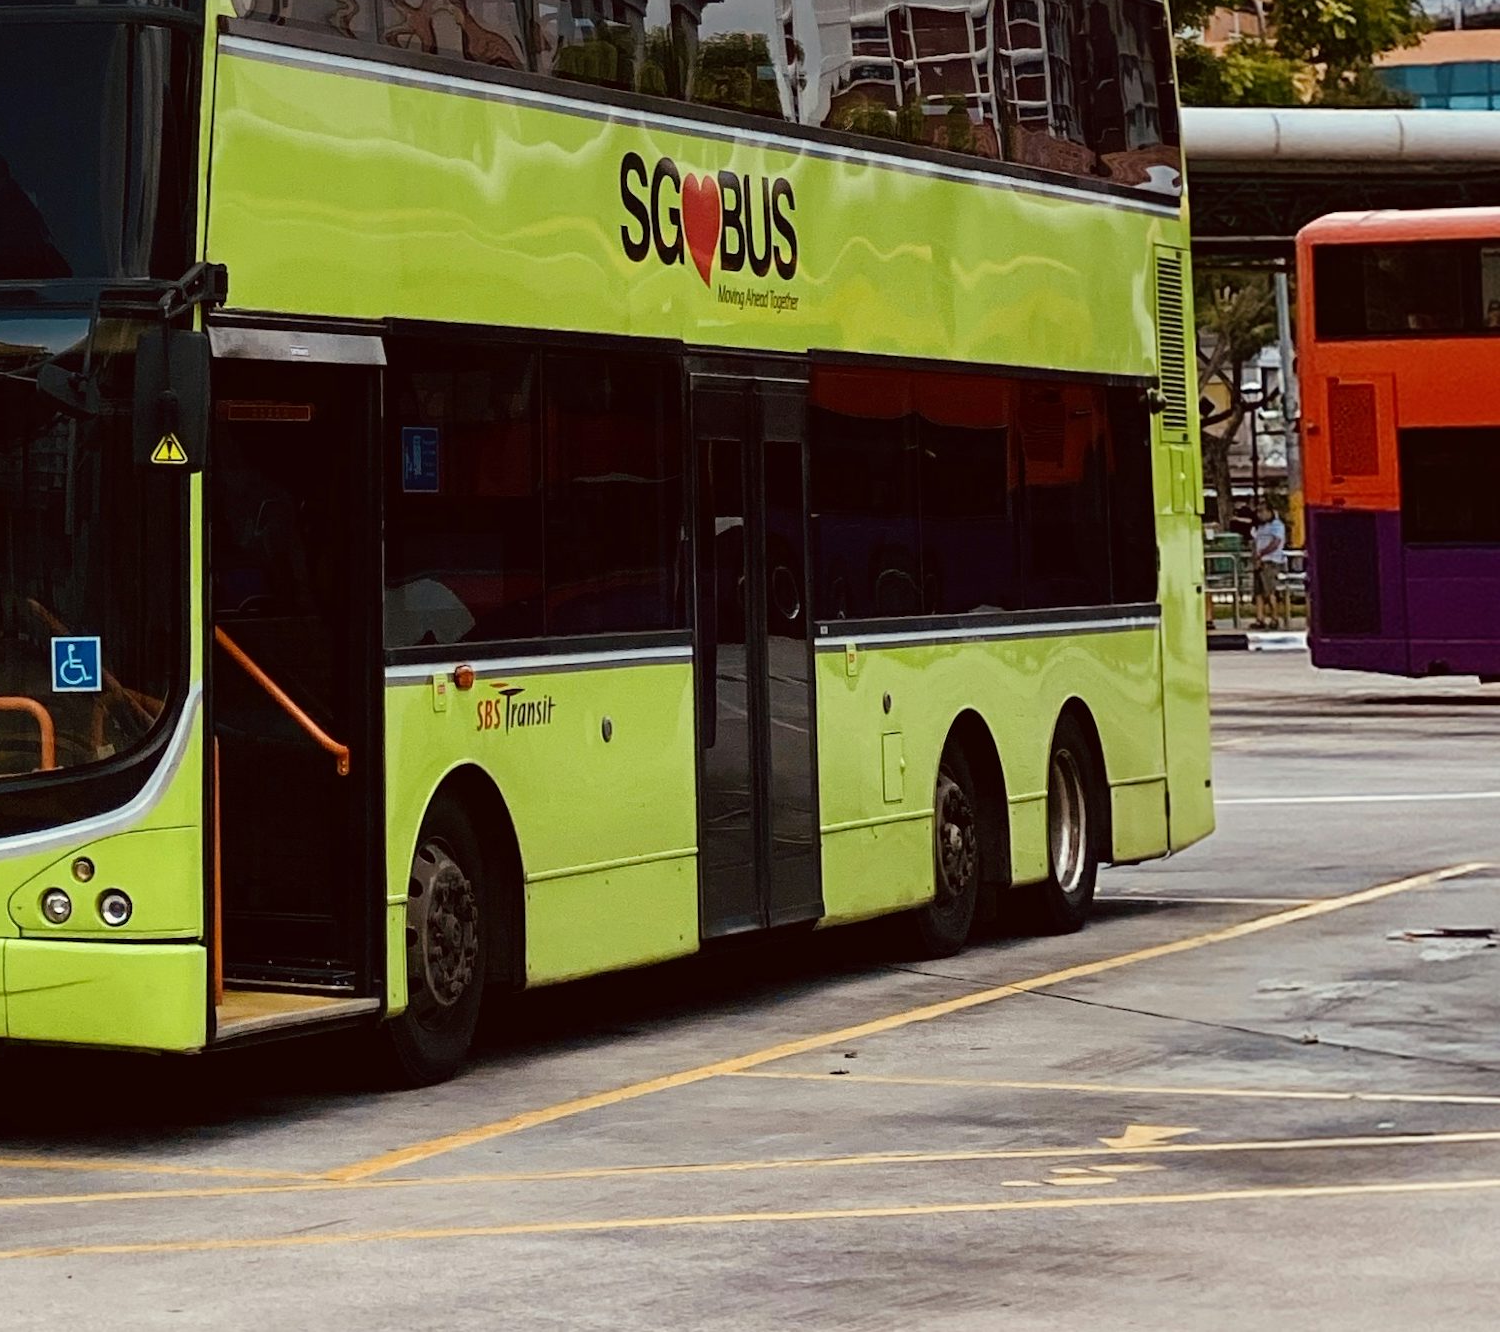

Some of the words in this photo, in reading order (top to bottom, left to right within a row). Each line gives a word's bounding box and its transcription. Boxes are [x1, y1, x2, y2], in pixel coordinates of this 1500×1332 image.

[717, 283, 745, 311] Moving
[745, 287, 769, 308] Ahead
[769, 289, 800, 314] Together
[476, 698, 501, 732] SBS
[498, 687, 557, 737] Transit
